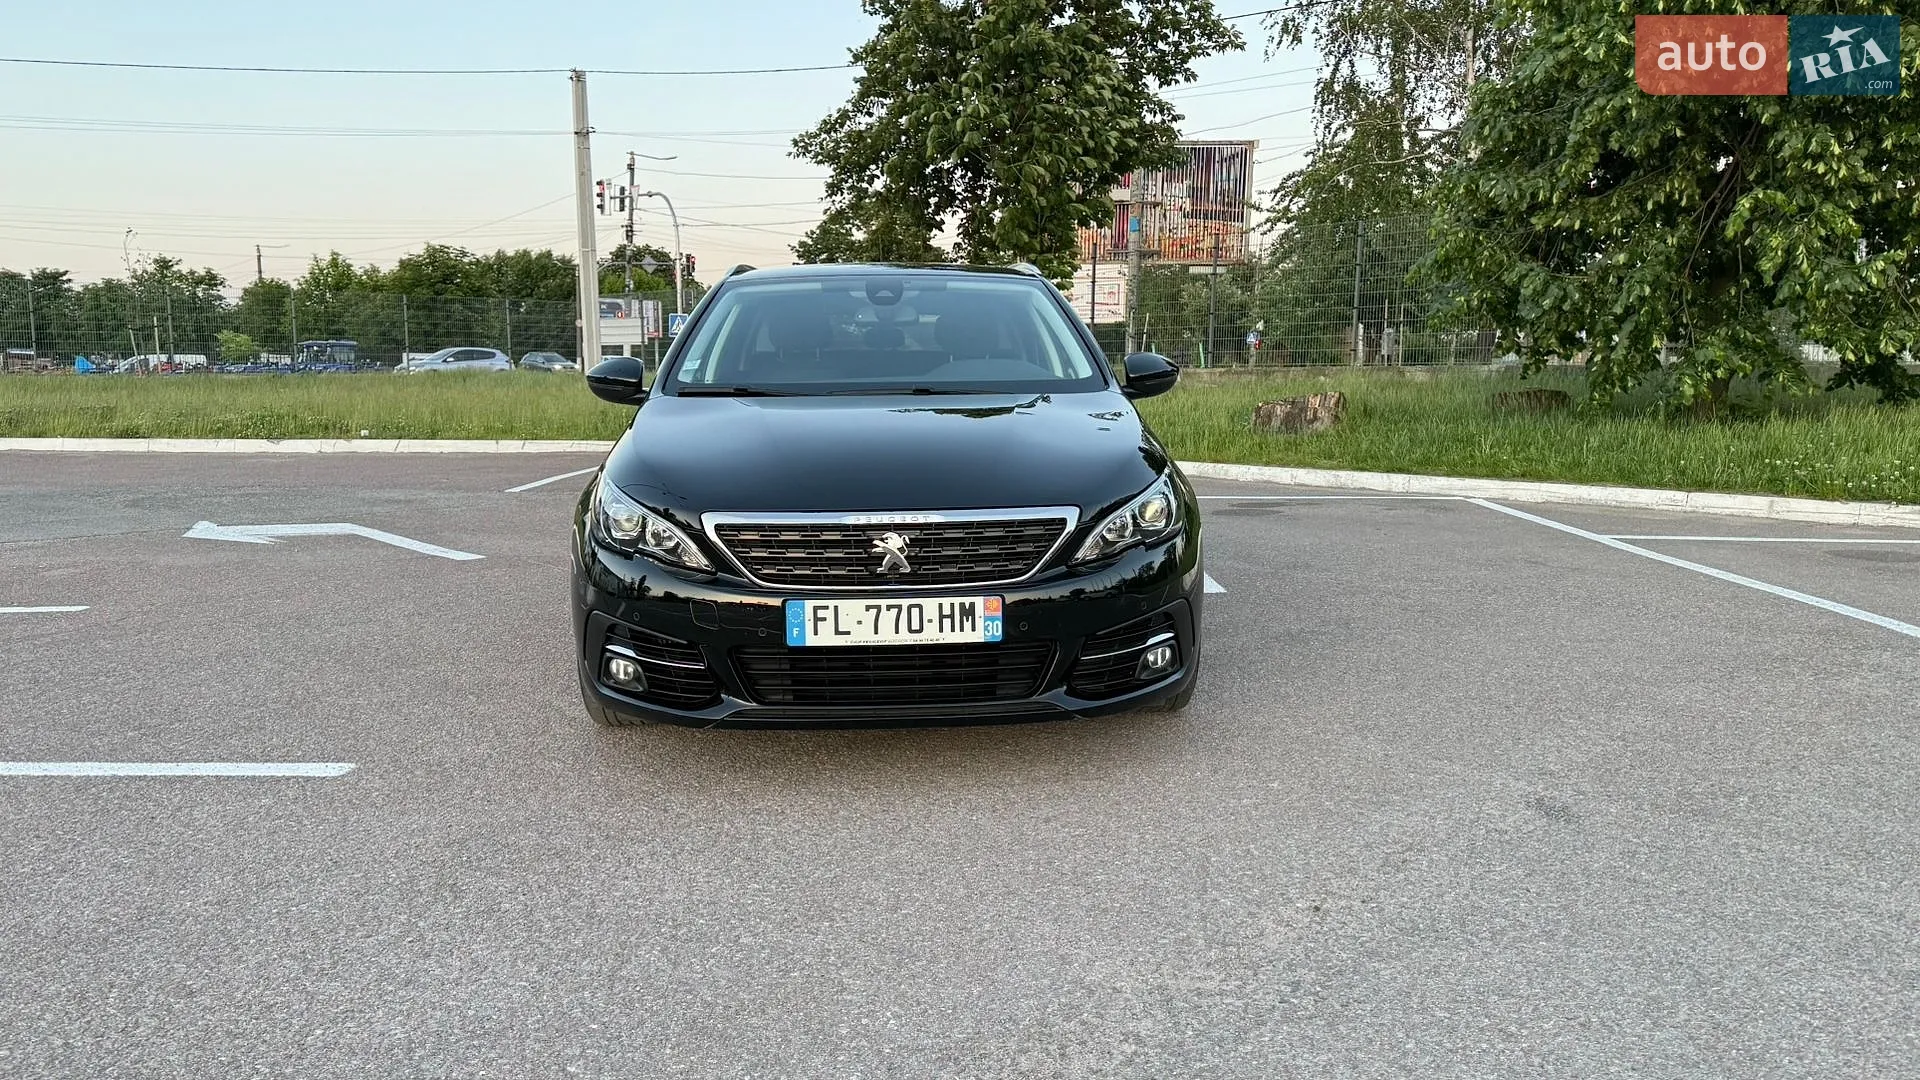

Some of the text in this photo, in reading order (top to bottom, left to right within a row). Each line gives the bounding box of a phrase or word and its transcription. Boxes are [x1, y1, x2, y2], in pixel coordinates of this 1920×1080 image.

[854, 515, 930, 523] PEUGEOT
[812, 602, 977, 636] FL-770-HM
[793, 627, 800, 638] F
[984, 620, 1002, 636] 30
